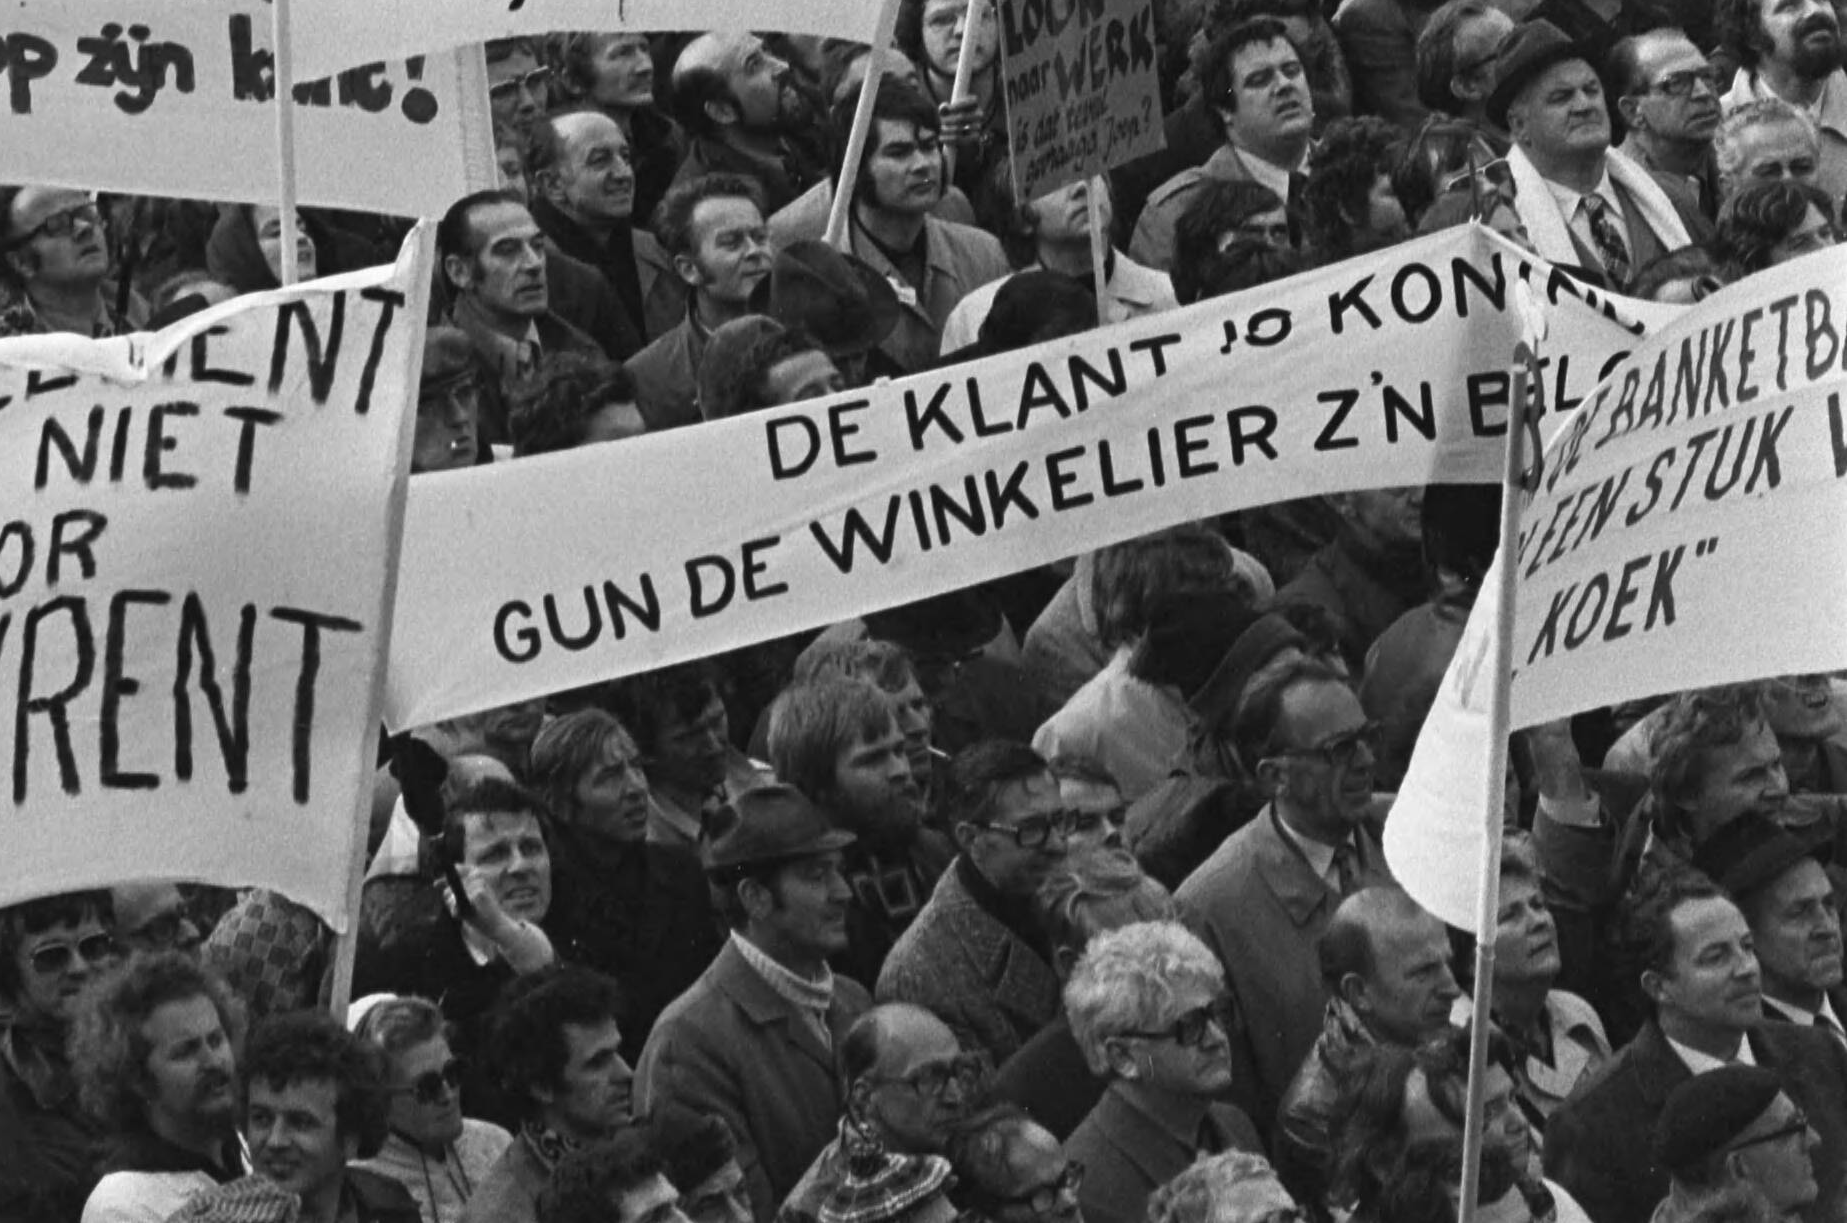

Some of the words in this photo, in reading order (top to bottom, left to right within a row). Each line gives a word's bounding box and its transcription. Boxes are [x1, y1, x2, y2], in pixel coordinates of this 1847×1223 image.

[1054, 3, 1154, 103] WERK
[763, 408, 877, 482] DE
[904, 332, 1183, 455] KLANT
[1329, 252, 1646, 335] KON
[1594, 287, 1847, 451] BANKETB
[34, 401, 283, 495] NIET
[493, 571, 661, 665] GUN
[687, 535, 789, 620] DE
[809, 413, 1280, 575] WINKELIER
[1313, 368, 1437, 455] Z'N
[1625, 405, 1794, 528] STUK
